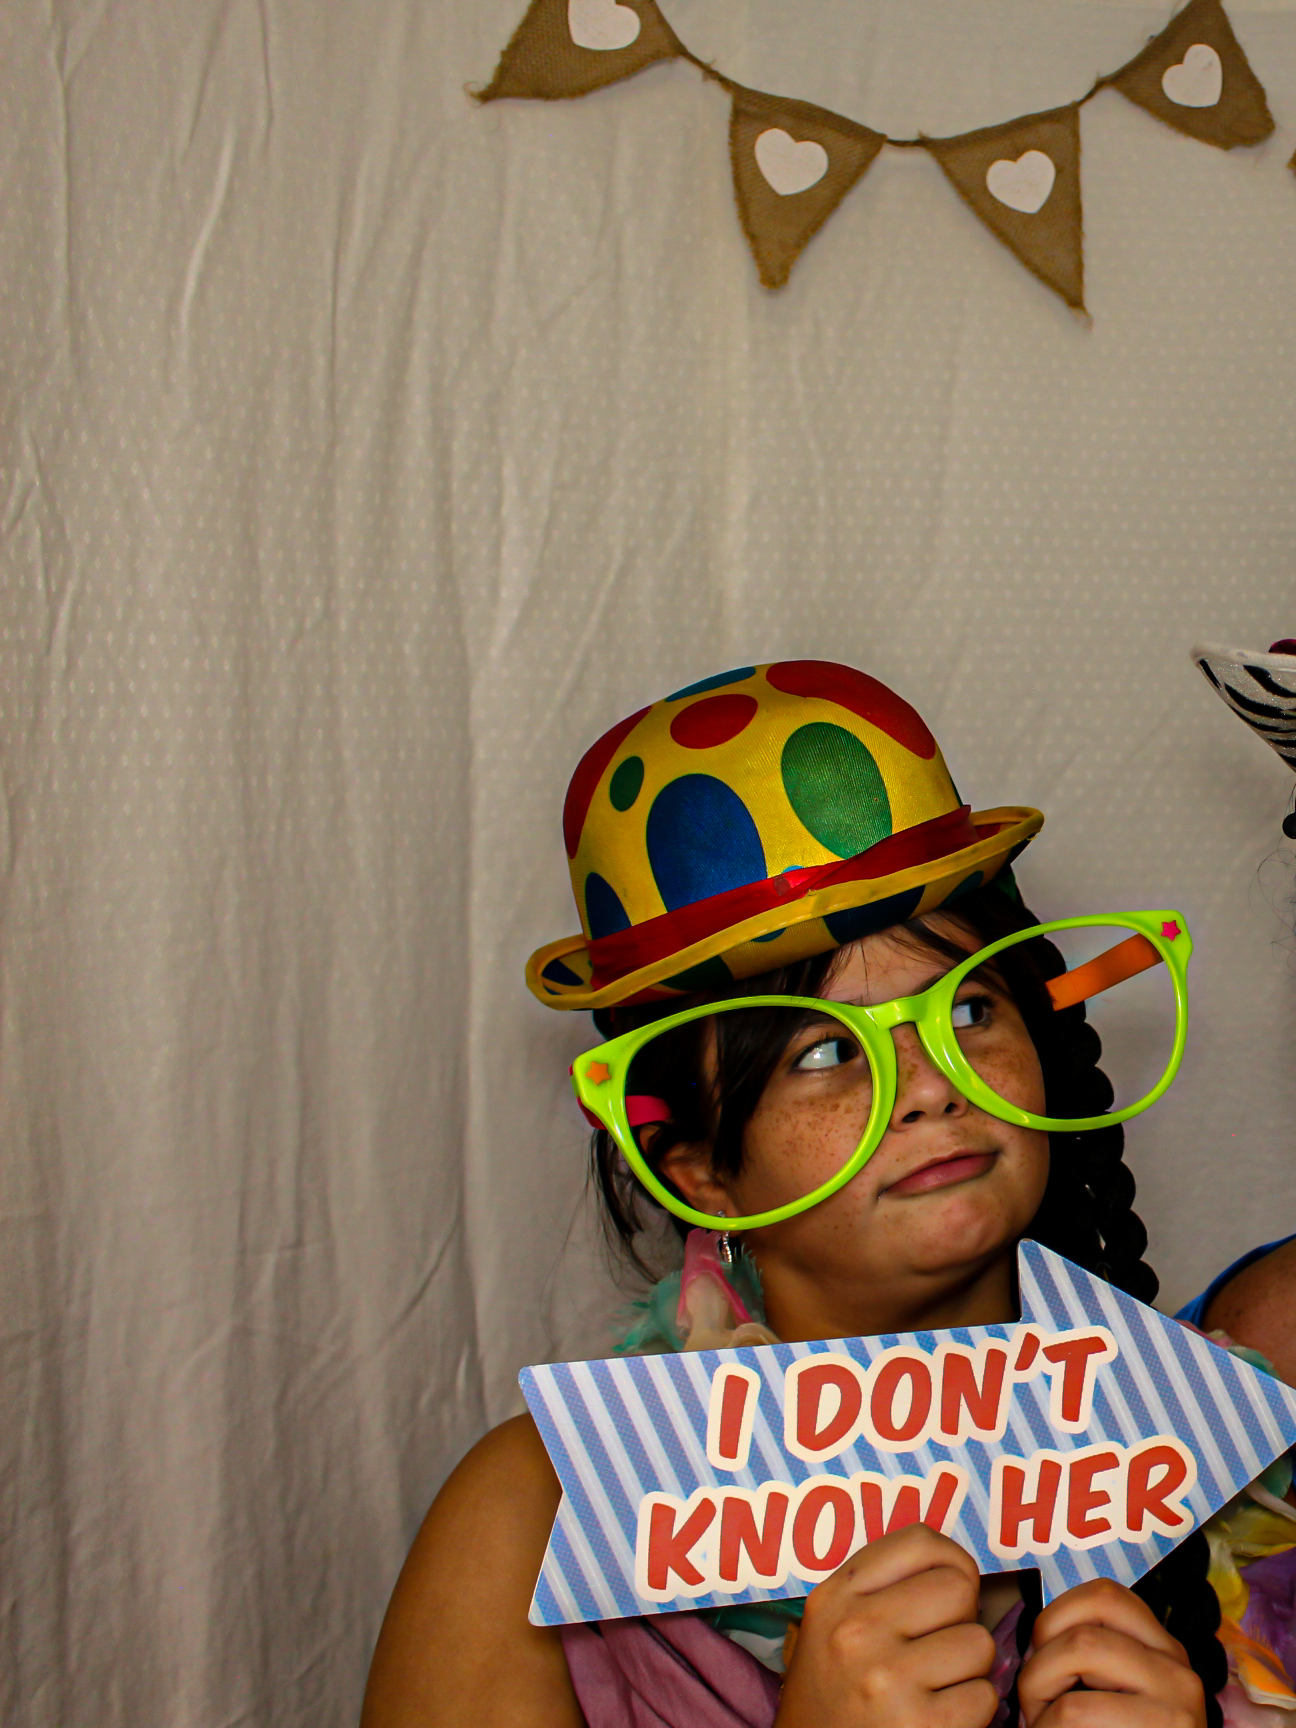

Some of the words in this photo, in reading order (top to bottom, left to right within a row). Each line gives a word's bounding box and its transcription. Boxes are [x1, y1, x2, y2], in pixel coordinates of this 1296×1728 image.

[718, 1374, 750, 1461] I
[795, 1331, 1107, 1453] DON'T
[999, 1445, 1187, 1548] HER
